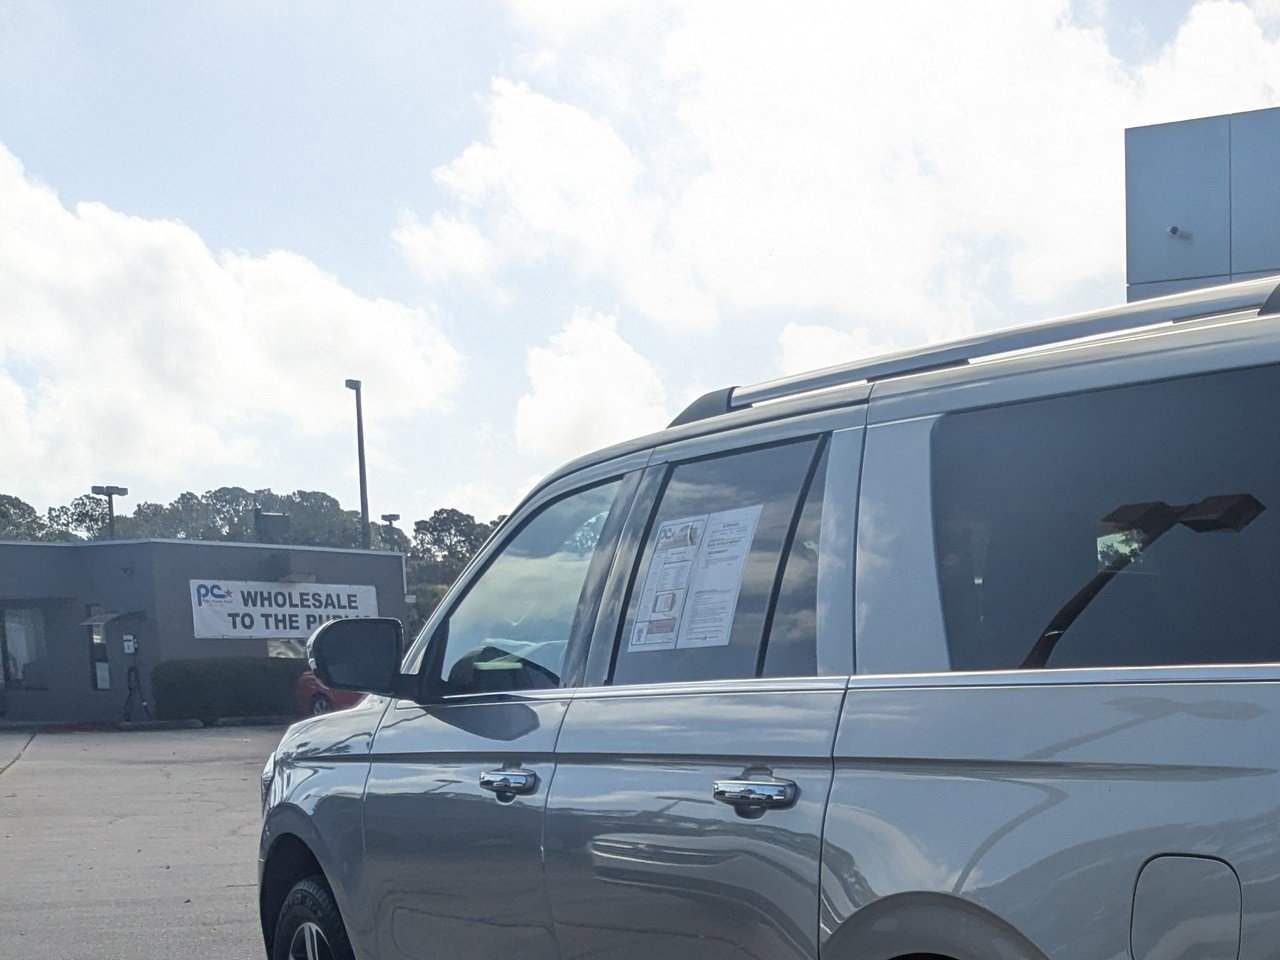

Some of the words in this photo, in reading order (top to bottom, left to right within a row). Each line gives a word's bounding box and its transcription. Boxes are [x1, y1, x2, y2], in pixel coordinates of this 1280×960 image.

[241, 590, 359, 610] WHOLESALE
[227, 612, 255, 630] TO
[261, 613, 300, 631] THE
